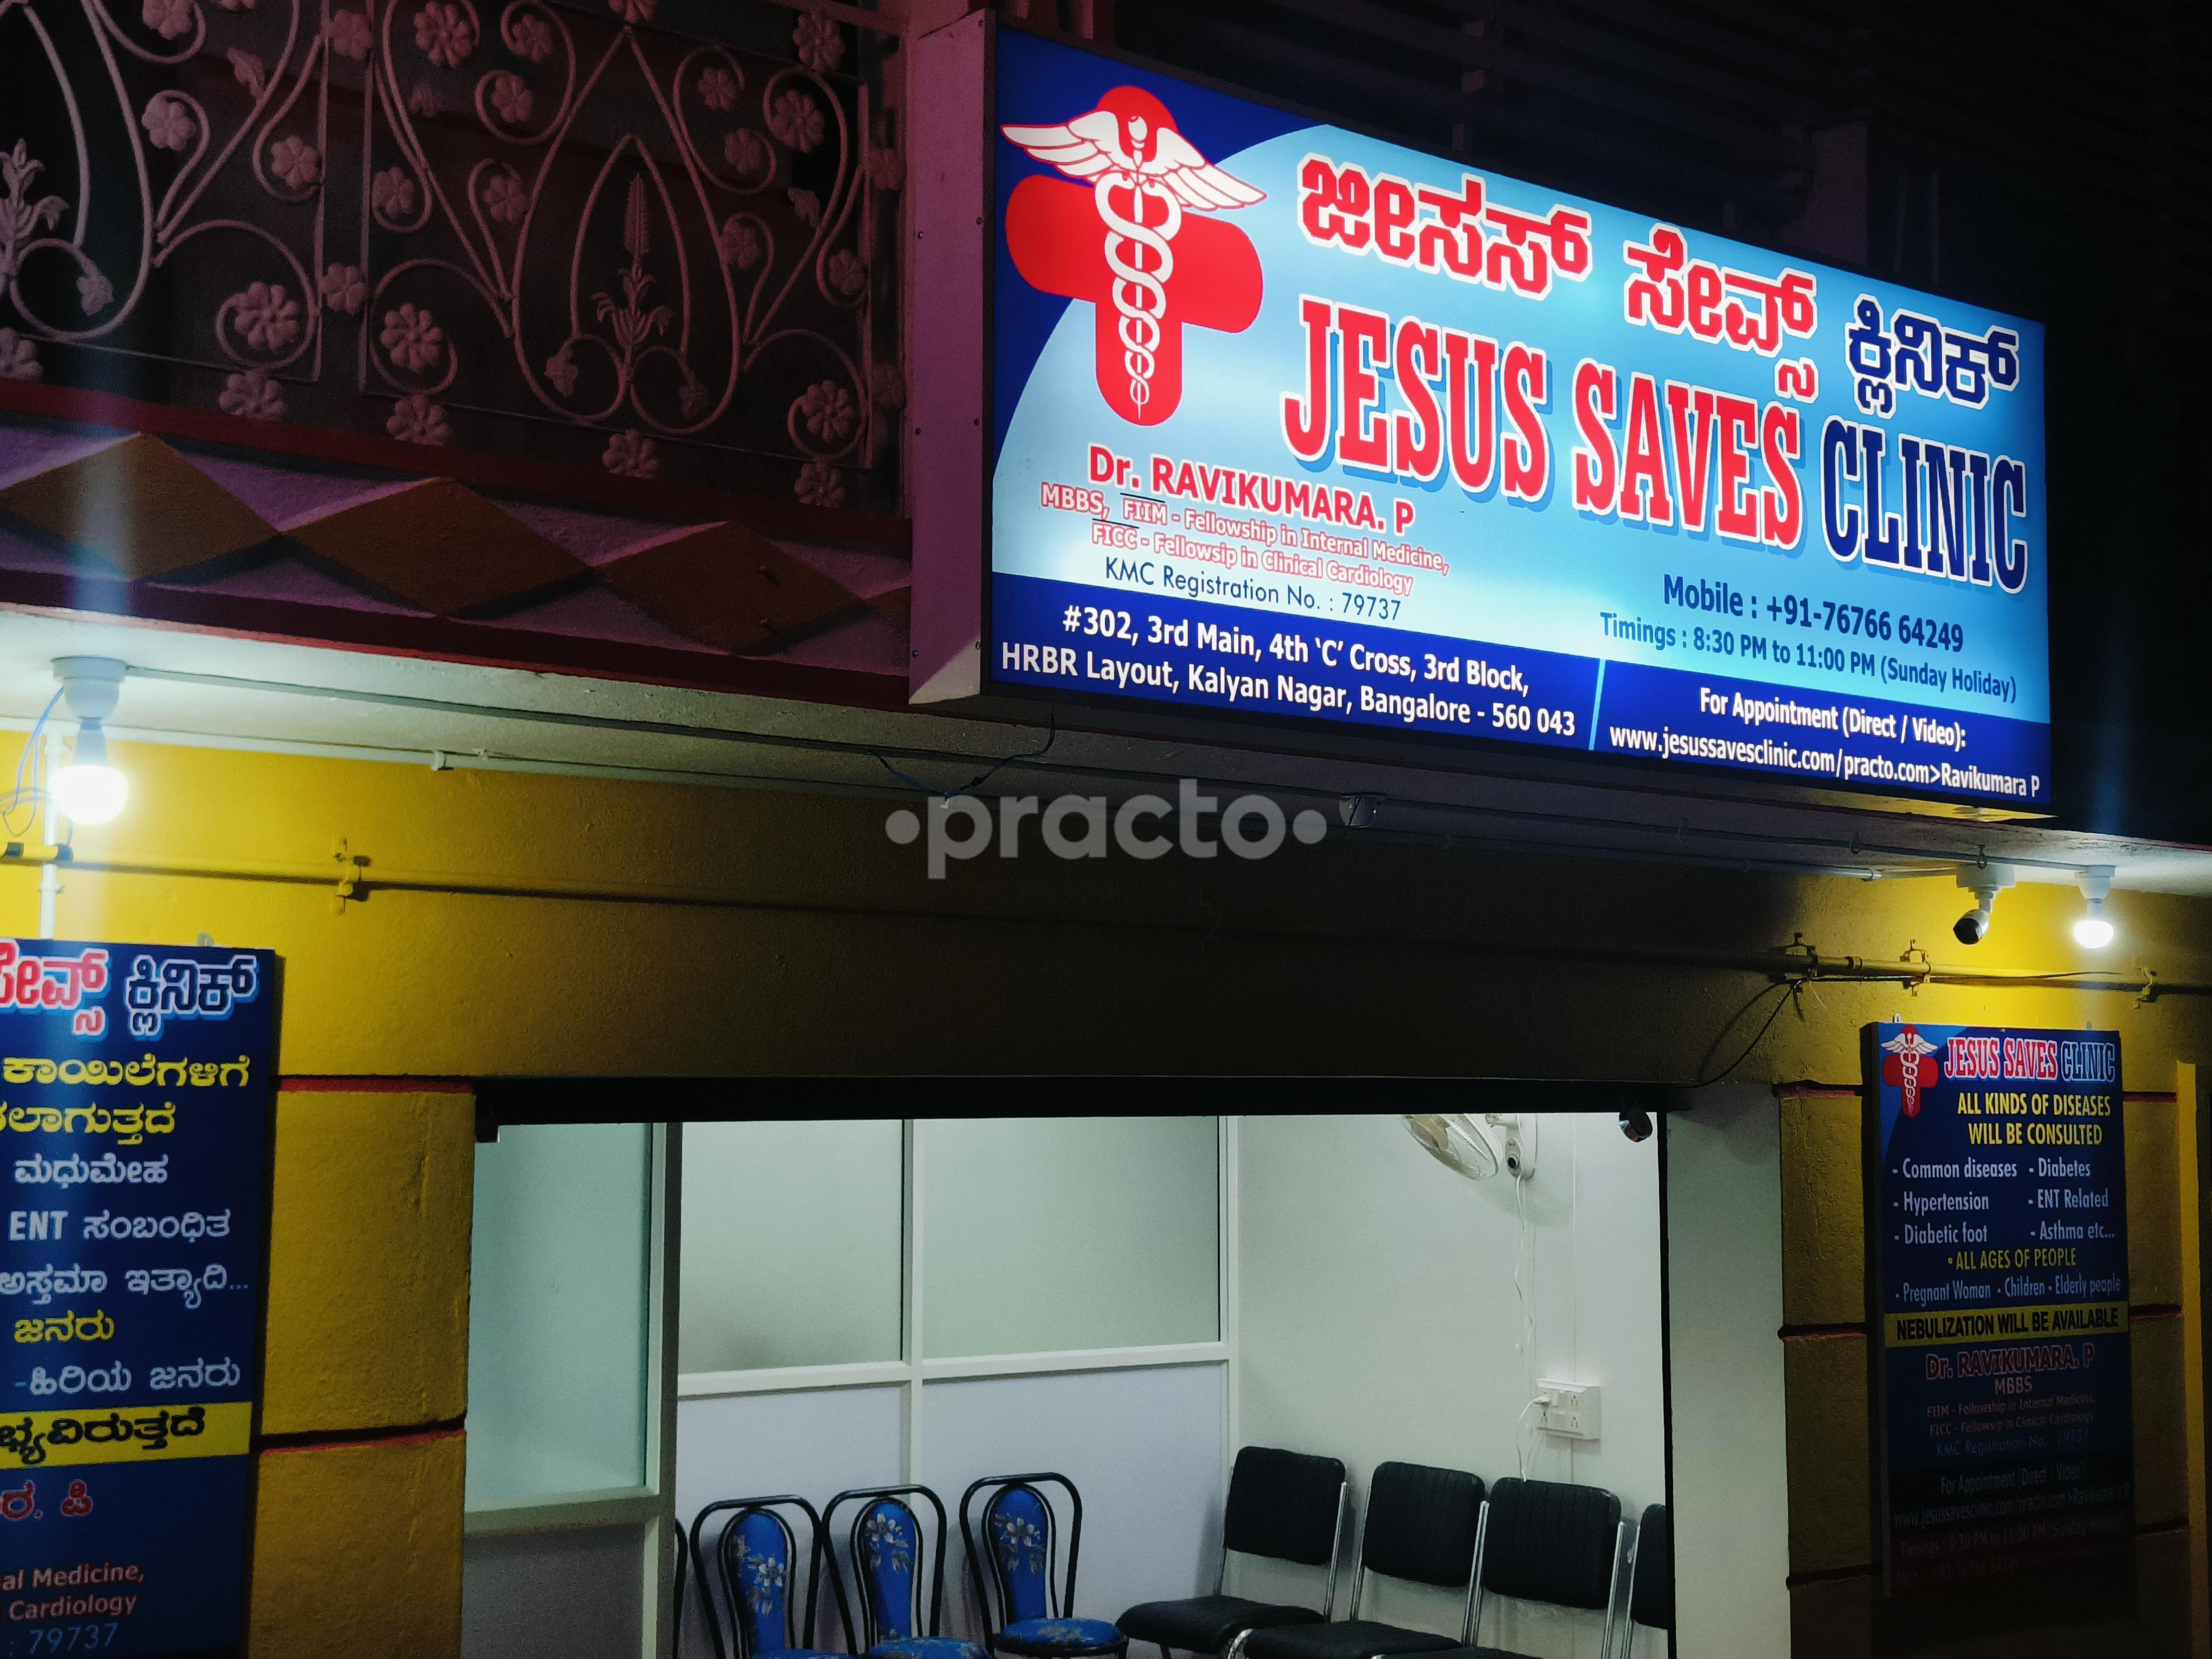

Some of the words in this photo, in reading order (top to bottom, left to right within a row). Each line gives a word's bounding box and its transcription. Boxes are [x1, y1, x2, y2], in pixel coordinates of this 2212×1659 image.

[1298, 153, 1592, 300] ಜೀಸಸ್
[1845, 293, 2021, 418] ಕ್ಲಿನಿಕ್
[1280, 293, 1548, 503] JESUS
[1572, 357, 1803, 549] SAVES
[1820, 415, 2028, 594] CLINIC
[1087, 442, 1140, 489] Dr.
[1150, 453, 1387, 531] RAVIKUMARA.
[1393, 498, 1415, 536] P
[1041, 482, 1110, 521] MBBS,
[1122, 498, 1167, 525] FIIM
[1185, 509, 1278, 545] Fellowship
[1280, 523, 1298, 548] in
[1301, 527, 1370, 557] Internal
[1373, 539, 1450, 577] Medicine,
[1091, 525, 1138, 550] FICC
[1154, 535, 1237, 569] Fellowsip
[1241, 547, 1259, 569] in
[1262, 550, 1322, 579] Clinical
[1326, 563, 1414, 596] Cardiology
[1106, 557, 1155, 585] KMC
[1163, 569, 1279, 604] Registration
[1288, 585, 1319, 610] No.
[1341, 592, 1401, 621] 79737
[1663, 574, 1743, 617] Mobile
[1766, 595, 1892, 641] +91-76766
[1897, 622, 1964, 652] 64249
[1062, 605, 1139, 647] #302,
[1147, 615, 1189, 648] 3rd
[1197, 623, 1262, 662] Main,
[1269, 632, 1309, 664] 4th
[1349, 643, 1417, 683] Cross,
[1423, 652, 1459, 684] 3rd
[1465, 661, 1529, 696] Block,
[1600, 611, 1676, 650] Timings
[1693, 628, 1735, 655] 8:30
[1740, 635, 1767, 660] PM
[1771, 638, 1791, 663] to
[1796, 642, 1845, 671] 11:00
[1850, 650, 1876, 677] PM
[1880, 656, 1947, 691] (Sunday
[1952, 666, 2017, 703] Holiday)
[1002, 642, 1077, 677] HRBR
[1086, 652, 1179, 694] Layout,
[1189, 664, 1269, 702] Kalyan
[1277, 677, 1353, 716] Nagar,
[1360, 686, 1471, 725] Bangalore
[1492, 704, 1532, 732] 560
[1536, 710, 1576, 737] 043
[1700, 688, 1728, 714] For
[1732, 693, 1839, 731] Appointment
[1842, 705, 1896, 740] (Direct
[1901, 714, 1908, 743] /
[1912, 718, 1966, 750] Video):
[2031, 776, 2040, 798] P
[3, 1053, 249, 1087] ಕಾಯಿಲೆಗಳಿಗೆ
[1944, 1037, 1999, 1080] JESUS
[2004, 1039, 2058, 1080] SAVES
[2060, 1041, 2115, 1082] CLINIC
[1958, 1092, 1981, 1115] ALL
[1985, 1093, 2027, 1114] KINDS
[2031, 1094, 2049, 1114] OF
[2053, 1095, 2111, 1116] DISEASES
[0, 1101, 176, 1145] ಲಾಗುತ್ತದೆ
[1968, 1123, 2002, 1144] WILL
[2006, 1123, 2022, 1144] BE
[2027, 1124, 2102, 1145] CONSULTED
[15, 1152, 168, 1188] ಮಧುಮೇಹ
[1903, 1157, 1959, 1178] Common
[1964, 1157, 2017, 1177] diseases
[2038, 1157, 2090, 1177] Diabetes
[1904, 1191, 1989, 1216] Hypertension
[2038, 1190, 2060, 1209] ENT
[2065, 1188, 2108, 1208] Related
[9, 1210, 68, 1240] ENT
[83, 1208, 231, 1243] ಸಂಬಂಧಿತ
[1905, 1224, 1959, 1244] Diabetic
[1963, 1222, 1987, 1242] foot
[2040, 1220, 2083, 1240] Asthma
[1980, 1250, 2010, 1269] AGES
[2015, 1249, 2030, 1267] OF
[2034, 1247, 2076, 1266] PEOPLE
[1903, 1283, 1950, 1307] Pregnant
[1953, 1281, 1991, 1299] Woman
[2005, 1277, 2045, 1297] Children
[2055, 1274, 2086, 1298] Elderly
[2089, 1273, 2121, 1296] people
[15, 1309, 115, 1344] ಜನರು
[1897, 1315, 1994, 1340] NEBULIZATION
[1998, 1312, 2028, 1333] WILL
[2032, 1312, 2048, 1332] BE
[2053, 1307, 2119, 1331] AVAILABLE
[150, 1357, 240, 1390] ಜನರು
[1926, 1354, 1953, 1379] Dr.
[1957, 1346, 2080, 1377] RAVIKUMARA.
[2083, 1343, 2095, 1367] P
[1994, 1376, 2032, 1394] MBBS
[0, 1569, 24, 1591] al
[32, 1562, 145, 1588] Medicine,
[9, 1594, 137, 1620] Cardiology
[29, 1622, 118, 1655] 79737
